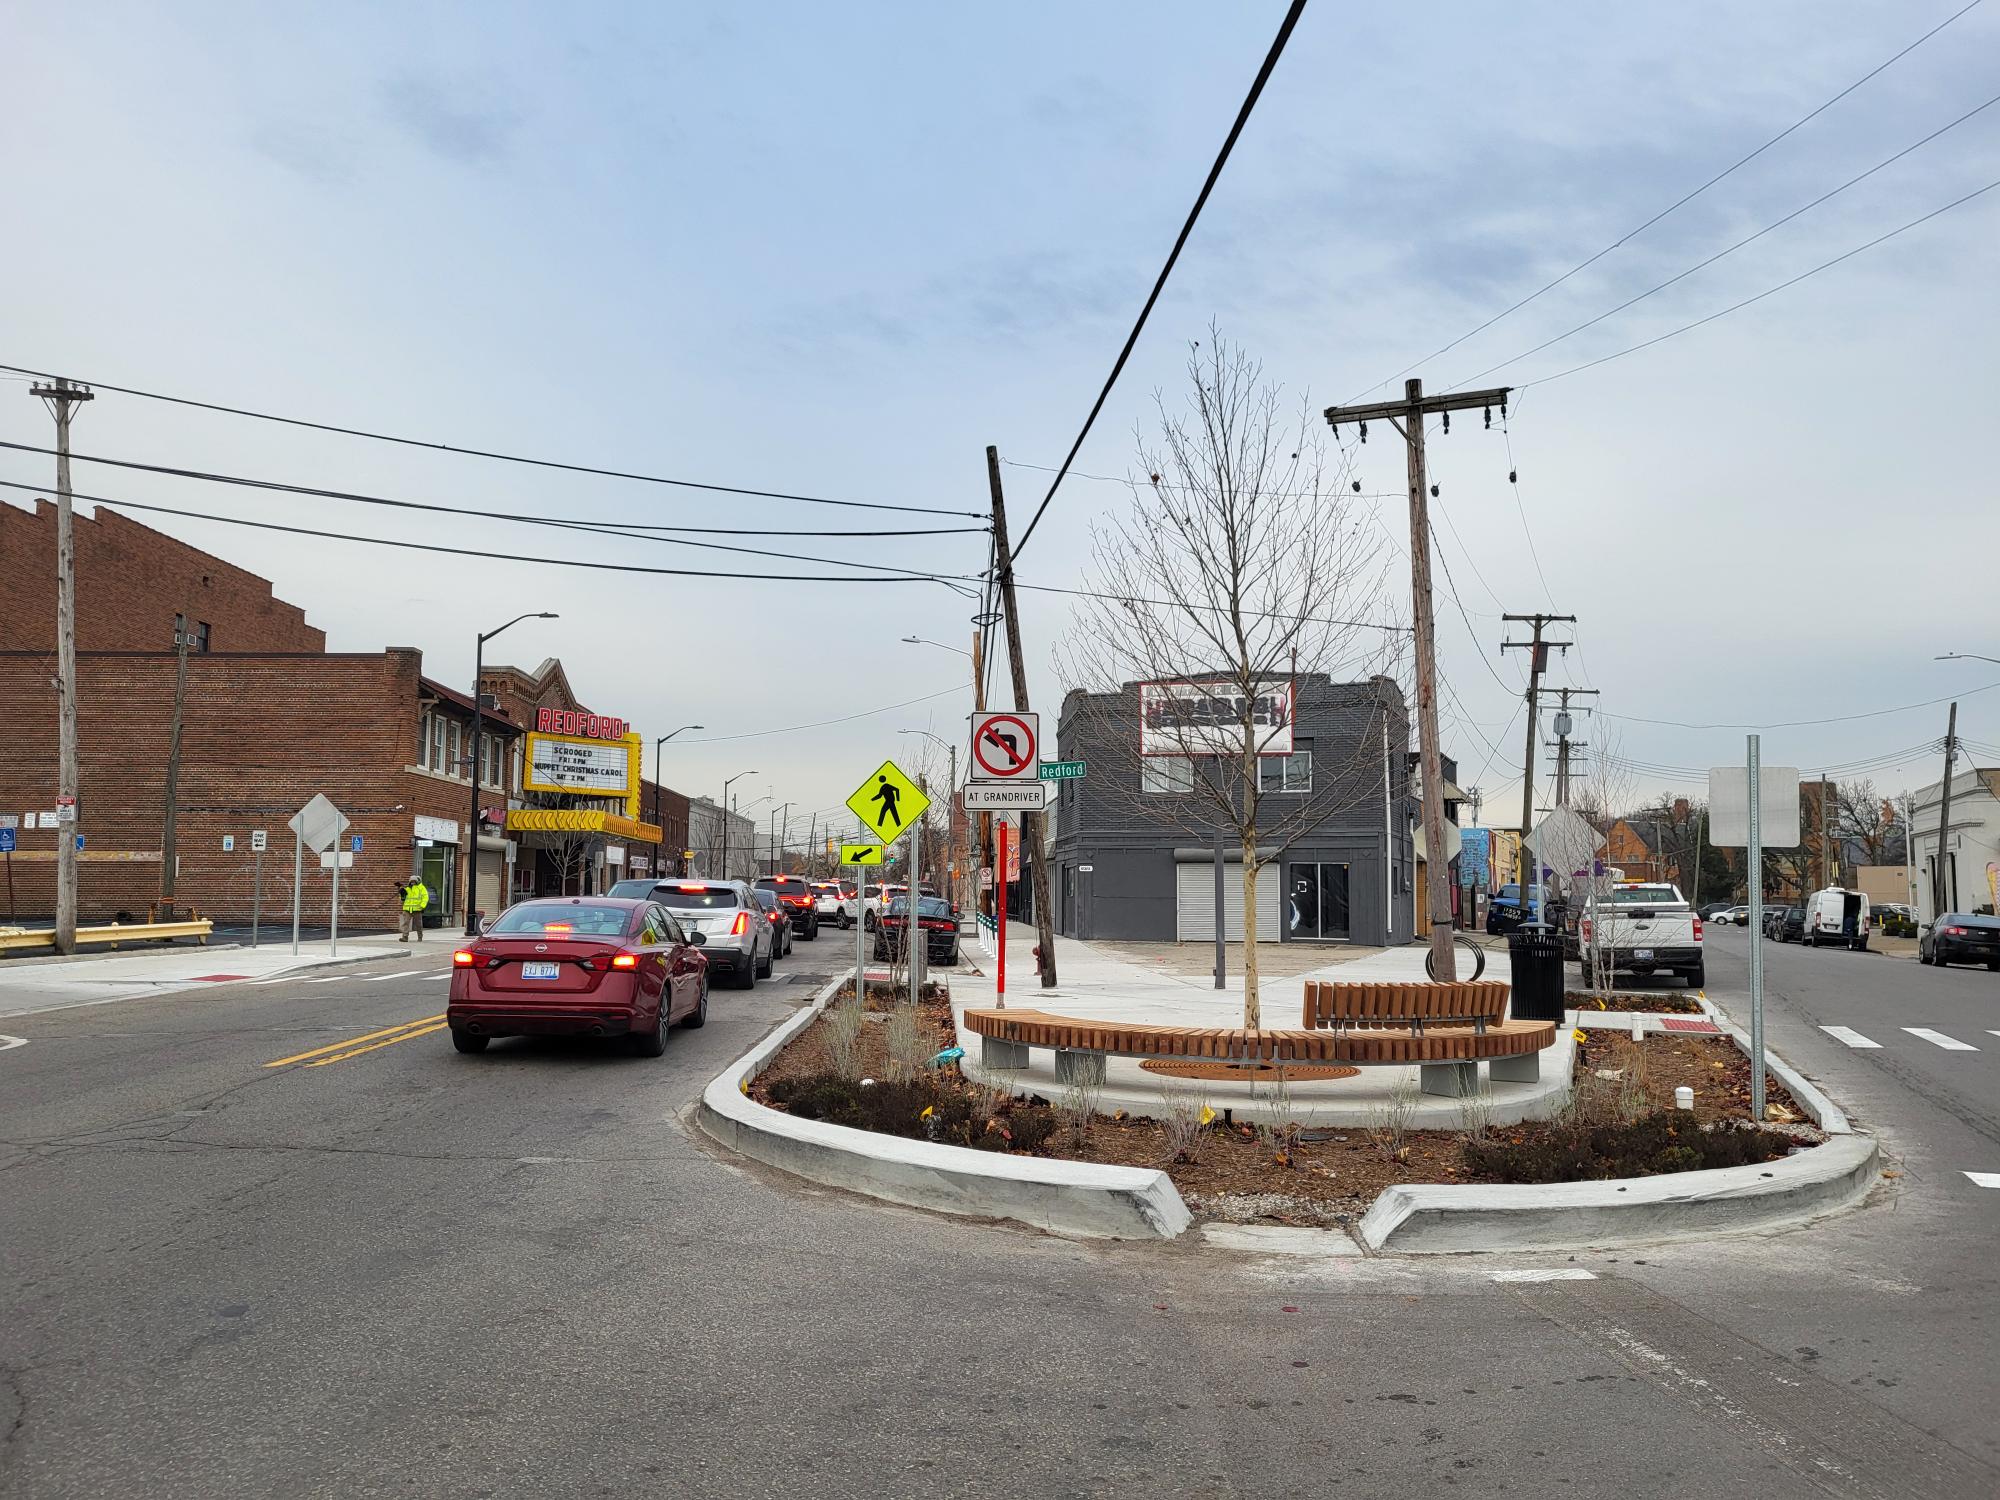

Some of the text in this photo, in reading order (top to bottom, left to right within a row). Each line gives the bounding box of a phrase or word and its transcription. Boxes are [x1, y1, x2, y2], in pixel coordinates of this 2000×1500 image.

[538, 707, 624, 741] REDFORD
[553, 746, 593, 757] SCROOGED
[534, 762, 623, 777] MUPPET CHRISTMAS CAROL
[1041, 763, 1084, 778] Redford
[968, 792, 1041, 802] AT GRANDRIVER
